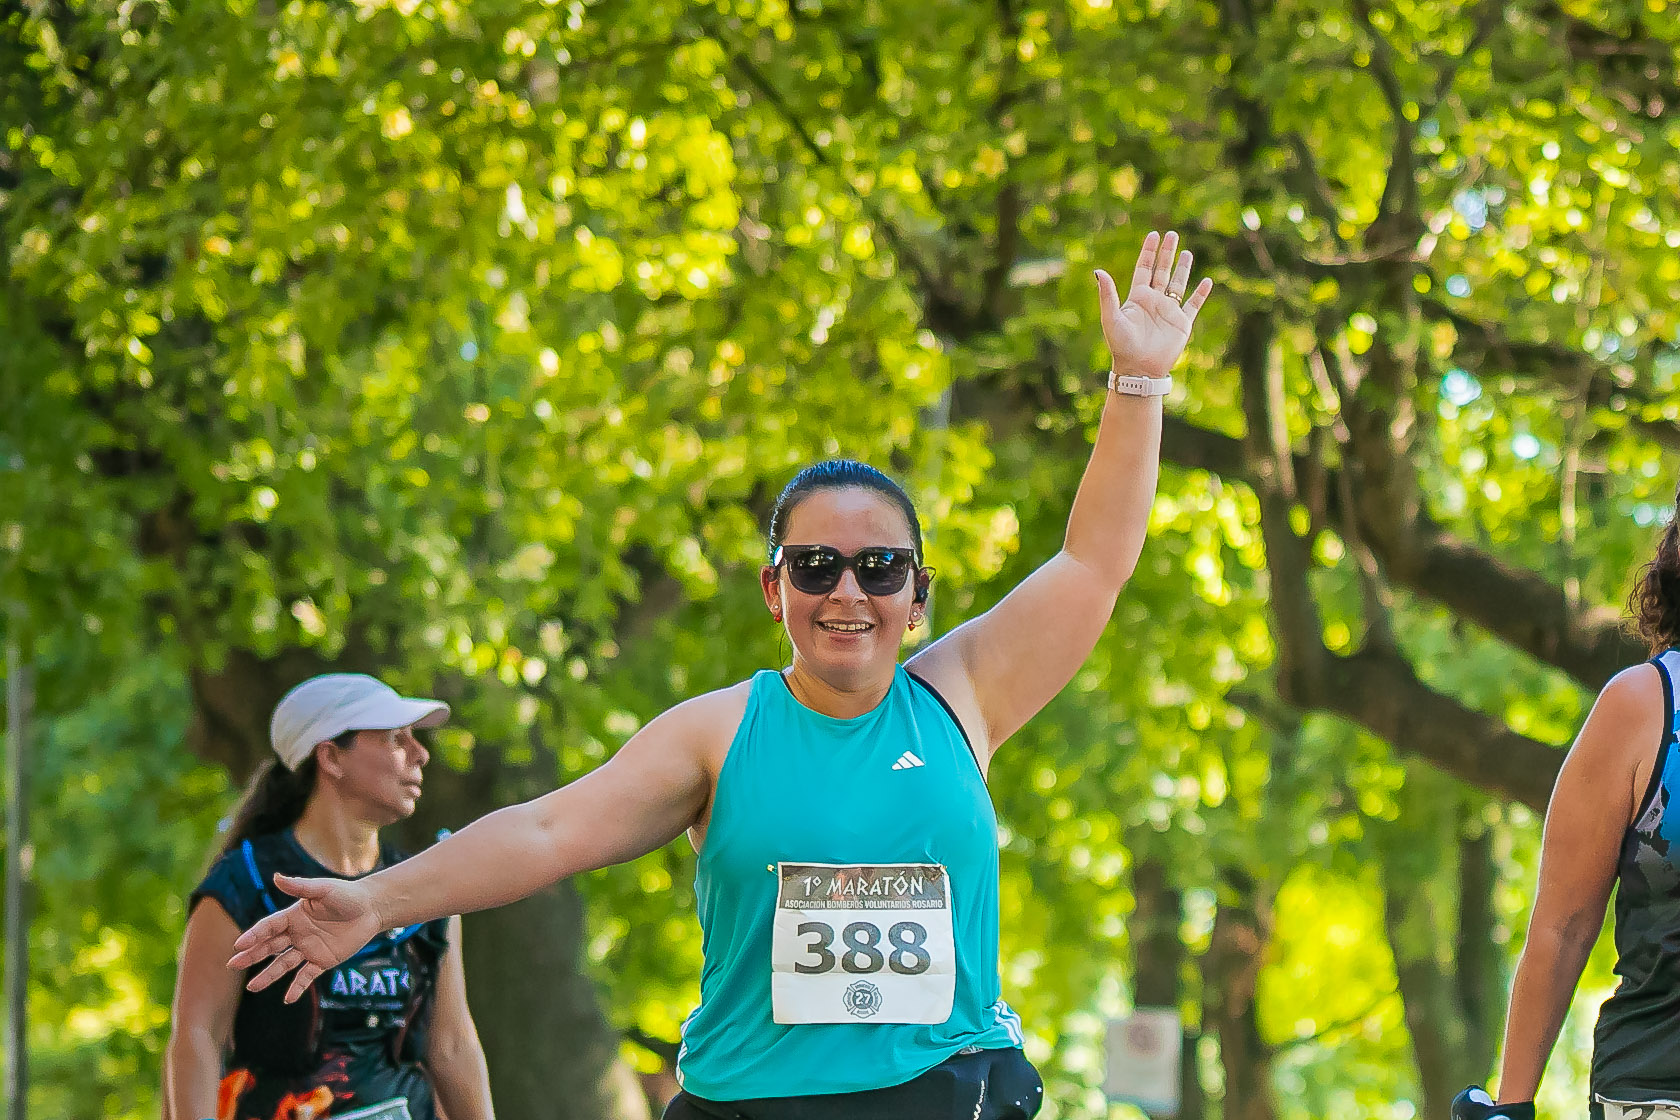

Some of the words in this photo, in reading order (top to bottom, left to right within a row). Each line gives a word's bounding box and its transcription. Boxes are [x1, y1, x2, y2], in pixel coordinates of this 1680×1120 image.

[826, 871, 924, 896] MARATÓN
[826, 900, 864, 909] BOMBEROS
[864, 900, 911, 909] VOLUNTARIOS
[911, 900, 943, 909] ROSARIO
[794, 921, 931, 975] 388
[855, 991, 871, 1005] 27
